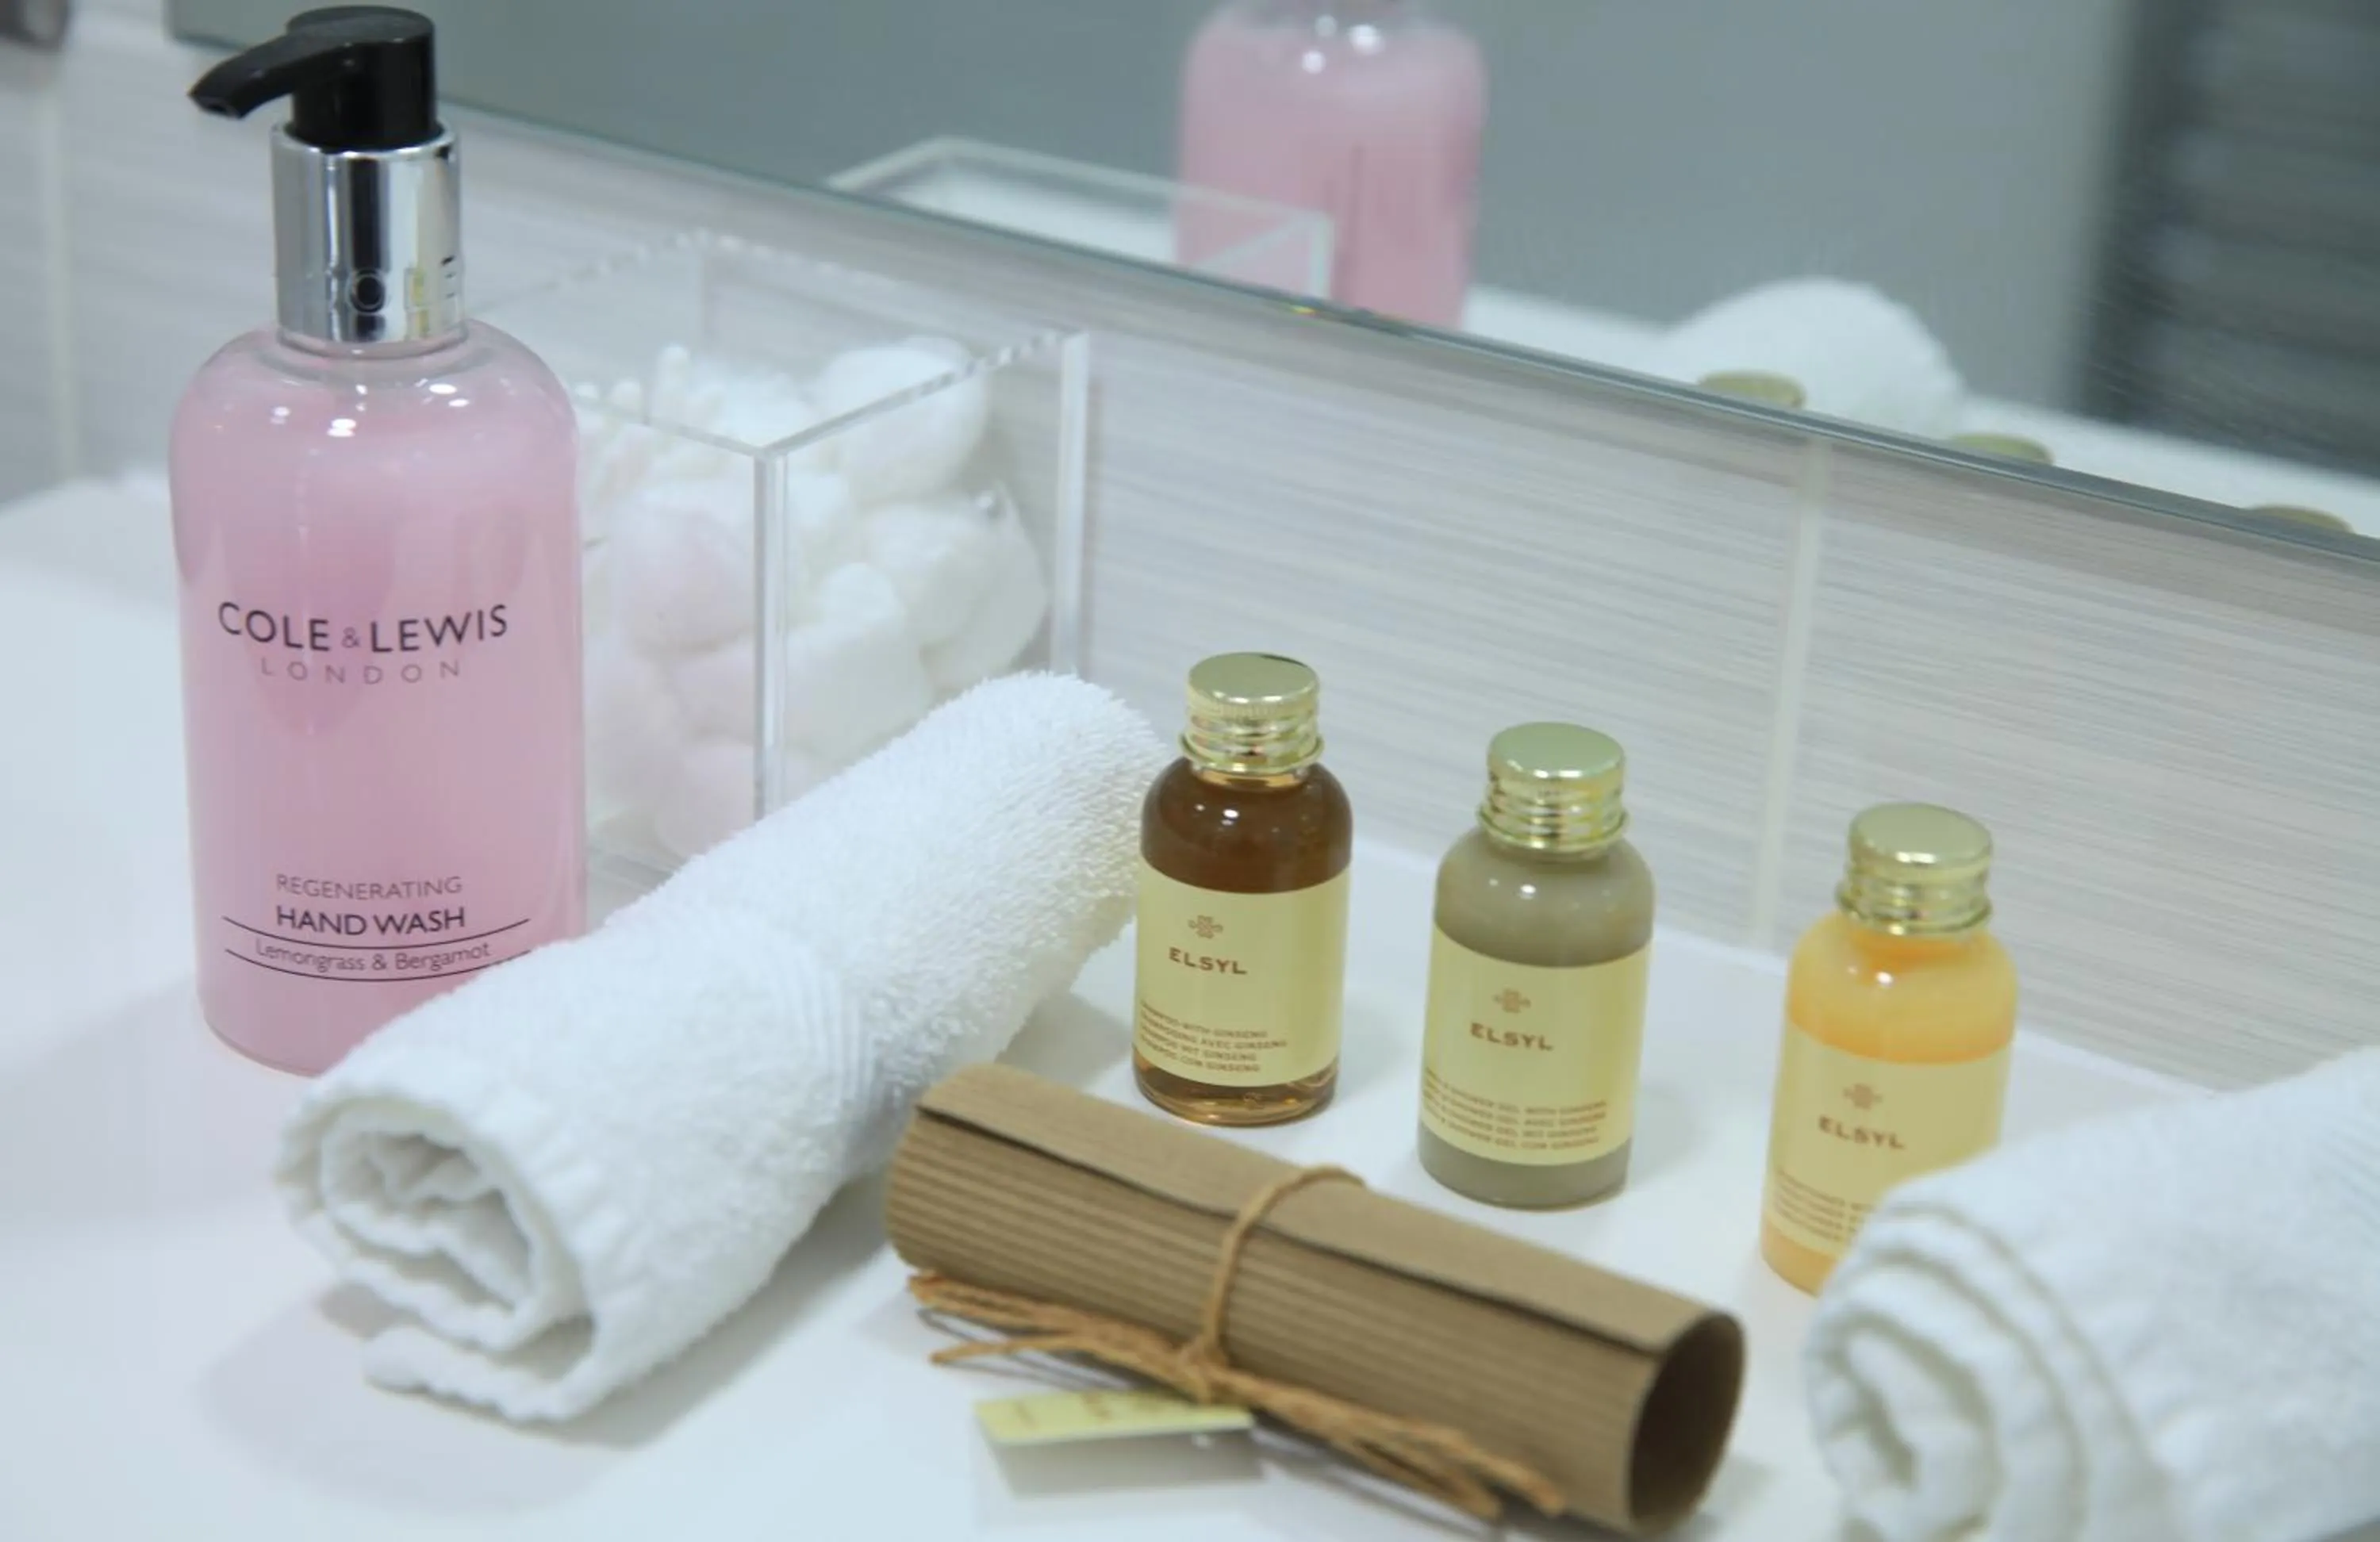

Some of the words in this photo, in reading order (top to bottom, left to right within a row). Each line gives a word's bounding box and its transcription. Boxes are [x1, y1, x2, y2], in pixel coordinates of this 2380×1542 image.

[218, 601, 330, 651] COLE
[342, 628, 362, 649] &
[370, 604, 508, 653] LEWIS
[261, 658, 460, 685] LONDON
[277, 873, 463, 900] REGENERATING
[276, 905, 368, 935] HAND
[373, 907, 466, 935] WASH
[255, 938, 365, 972] Lemongrass
[371, 955, 387, 971] &
[395, 942, 490, 971] Bergamot
[1169, 947, 1248, 975] ELSYL
[1470, 1022, 1554, 1052] ELSYL
[1818, 1114, 1906, 1150] ELSYL
